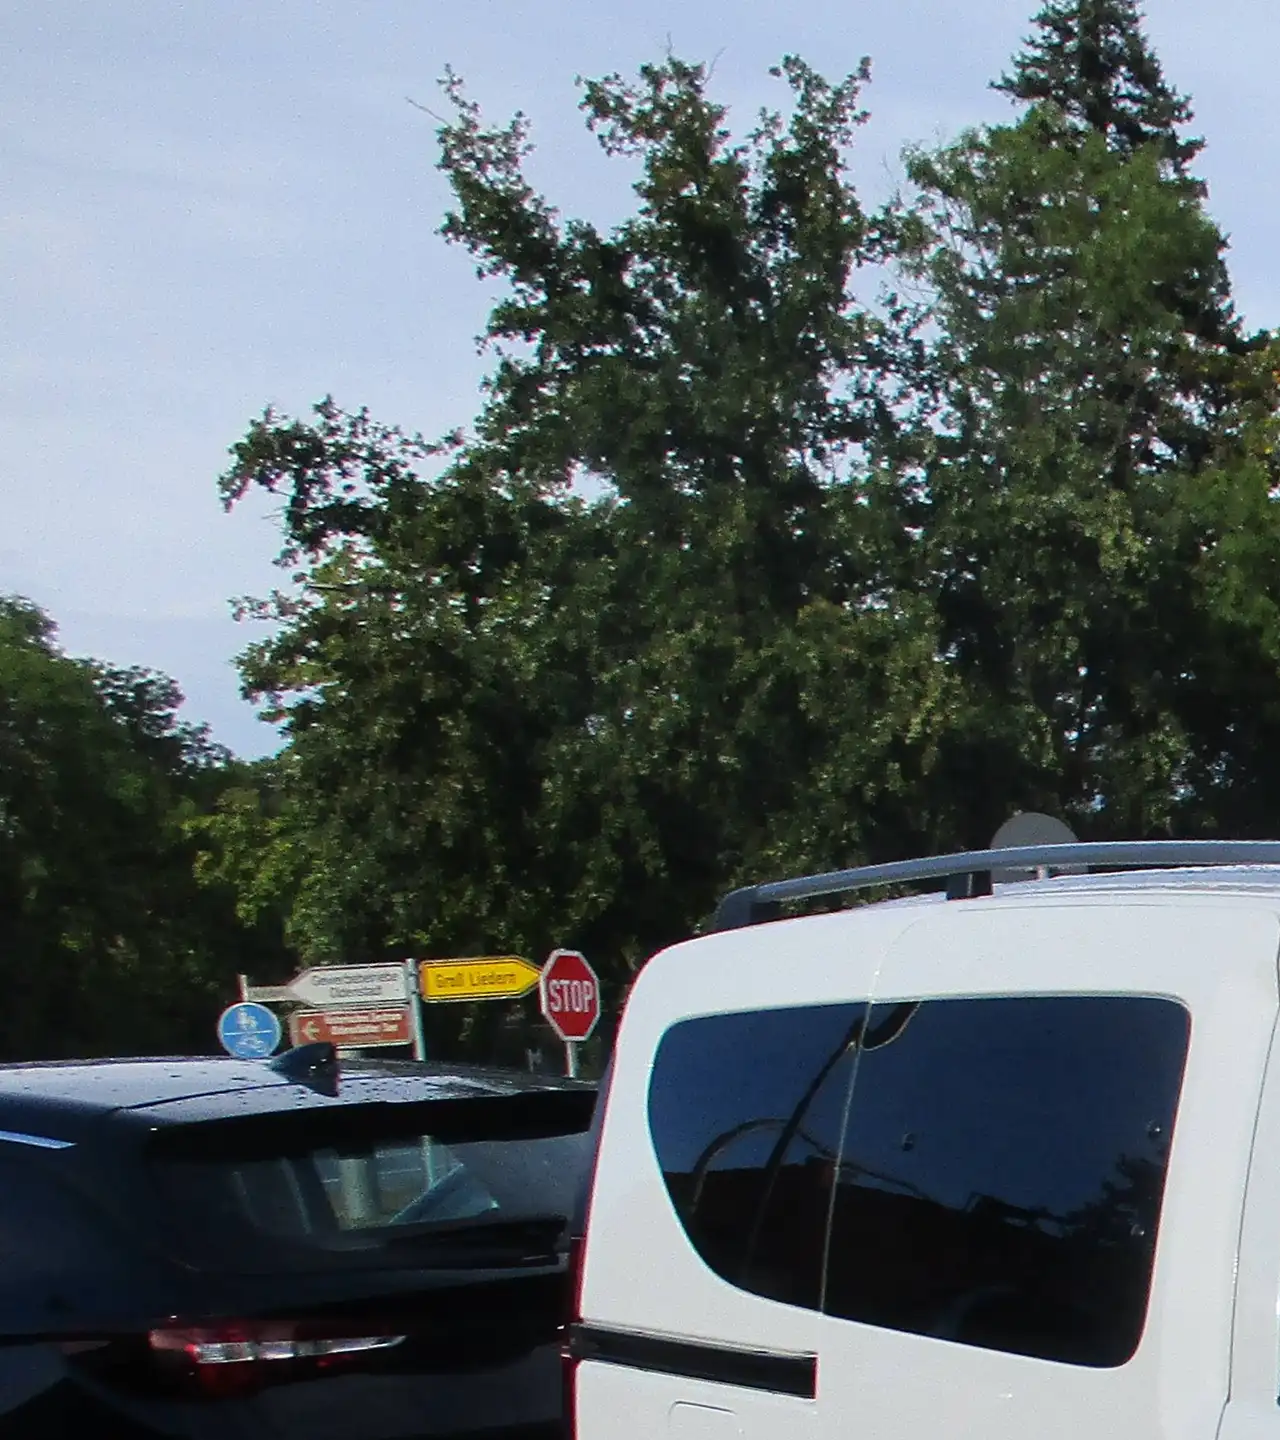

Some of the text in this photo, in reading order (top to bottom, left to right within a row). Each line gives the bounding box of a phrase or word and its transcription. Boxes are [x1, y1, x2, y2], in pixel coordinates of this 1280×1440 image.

[435, 970, 517, 989] Groß Liedern
[550, 979, 594, 1013] STOP
